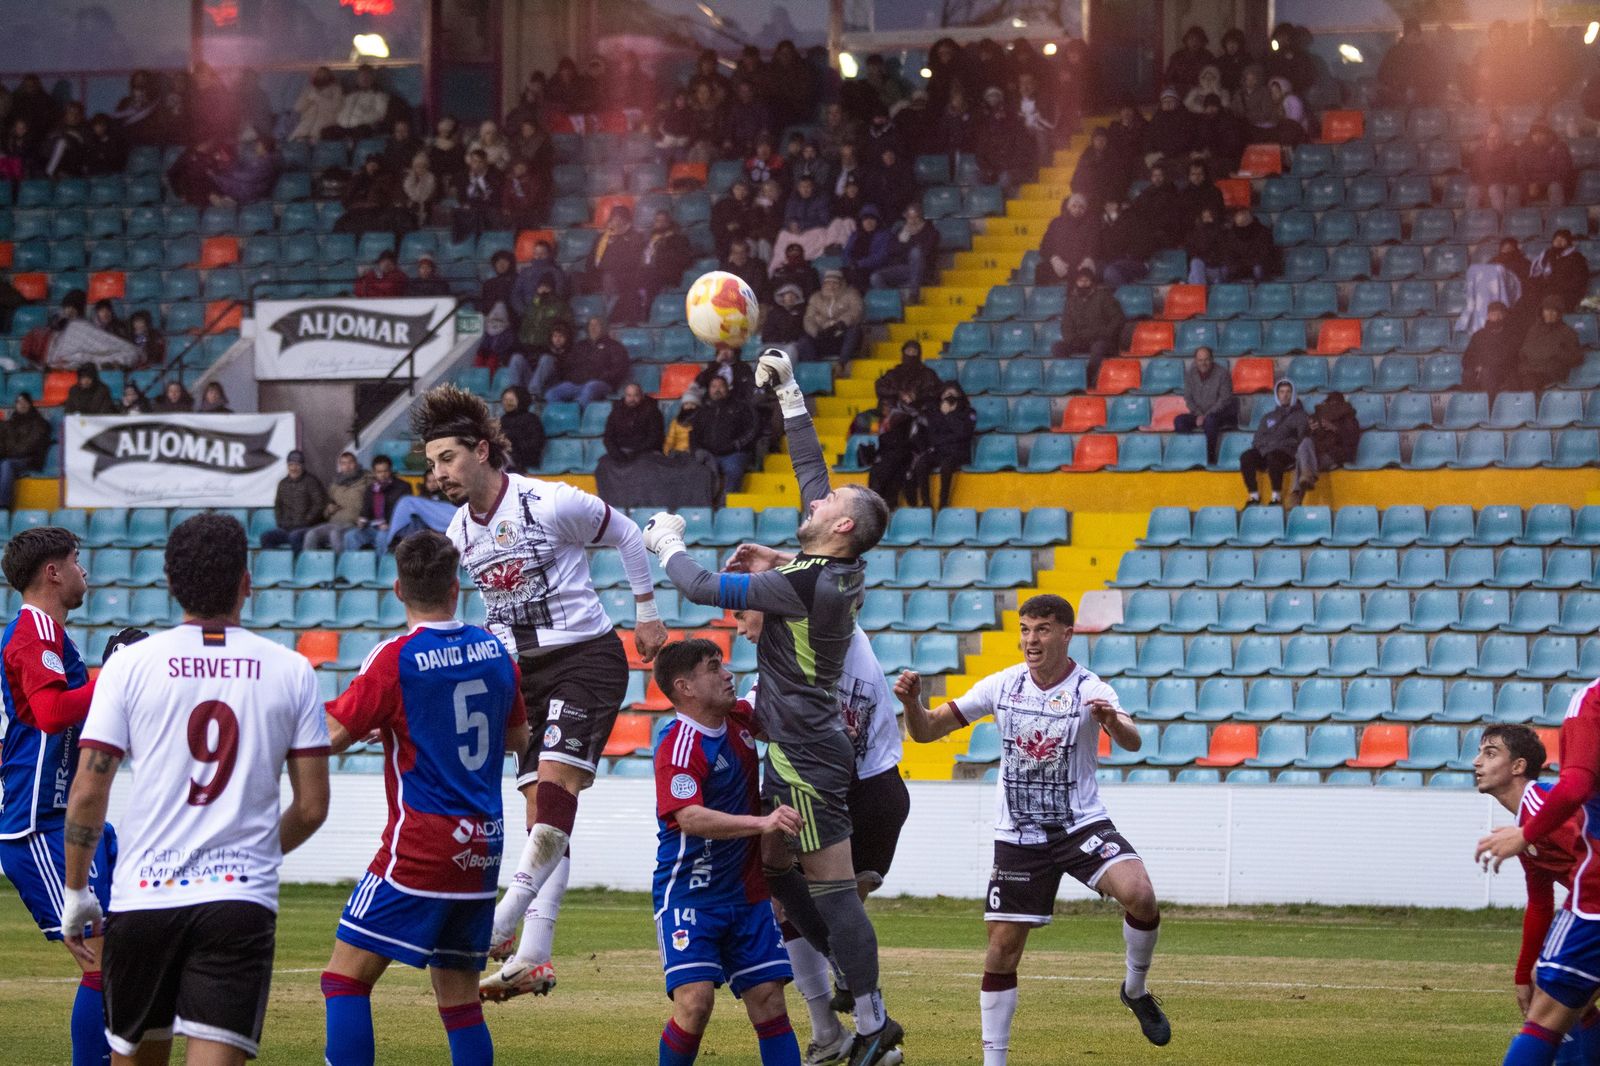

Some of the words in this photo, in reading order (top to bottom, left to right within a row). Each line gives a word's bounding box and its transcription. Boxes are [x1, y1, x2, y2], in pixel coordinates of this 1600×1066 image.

[299, 312, 410, 345] ALJOMAR
[116, 430, 247, 468] ALJOMAR
[168, 657, 261, 680] SERVETTI
[414, 645, 463, 672] DAVID
[452, 678, 490, 771] 5
[187, 699, 240, 807] 9
[989, 886, 1001, 910] 6
[673, 908, 697, 927] 14
